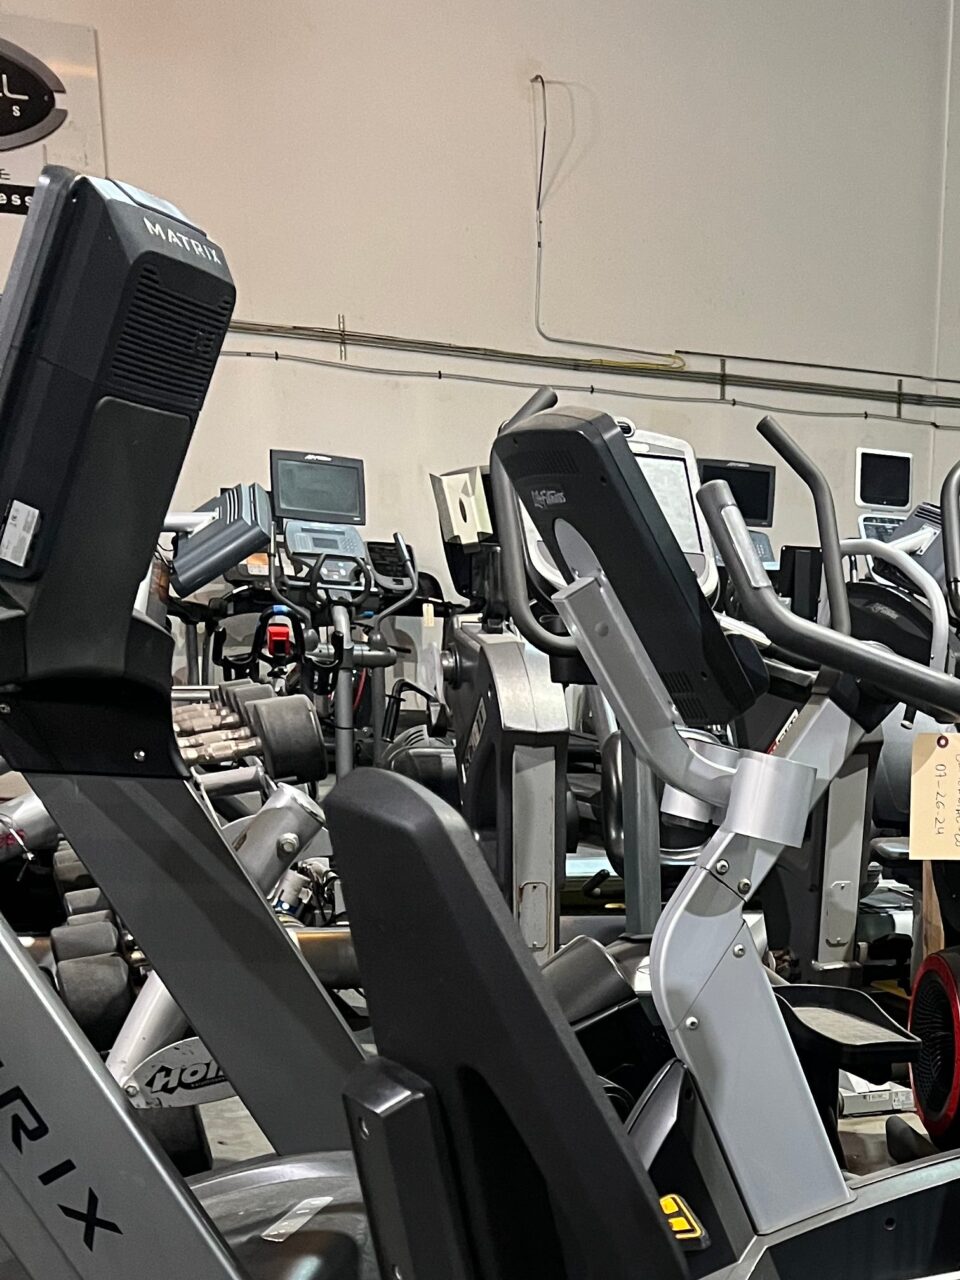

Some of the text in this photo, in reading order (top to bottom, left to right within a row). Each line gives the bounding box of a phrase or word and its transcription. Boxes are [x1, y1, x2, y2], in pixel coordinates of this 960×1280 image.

[143, 216, 222, 265] MATRIX
[151, 1060, 225, 1092] HOI
[0, 1058, 124, 1253] RIX
